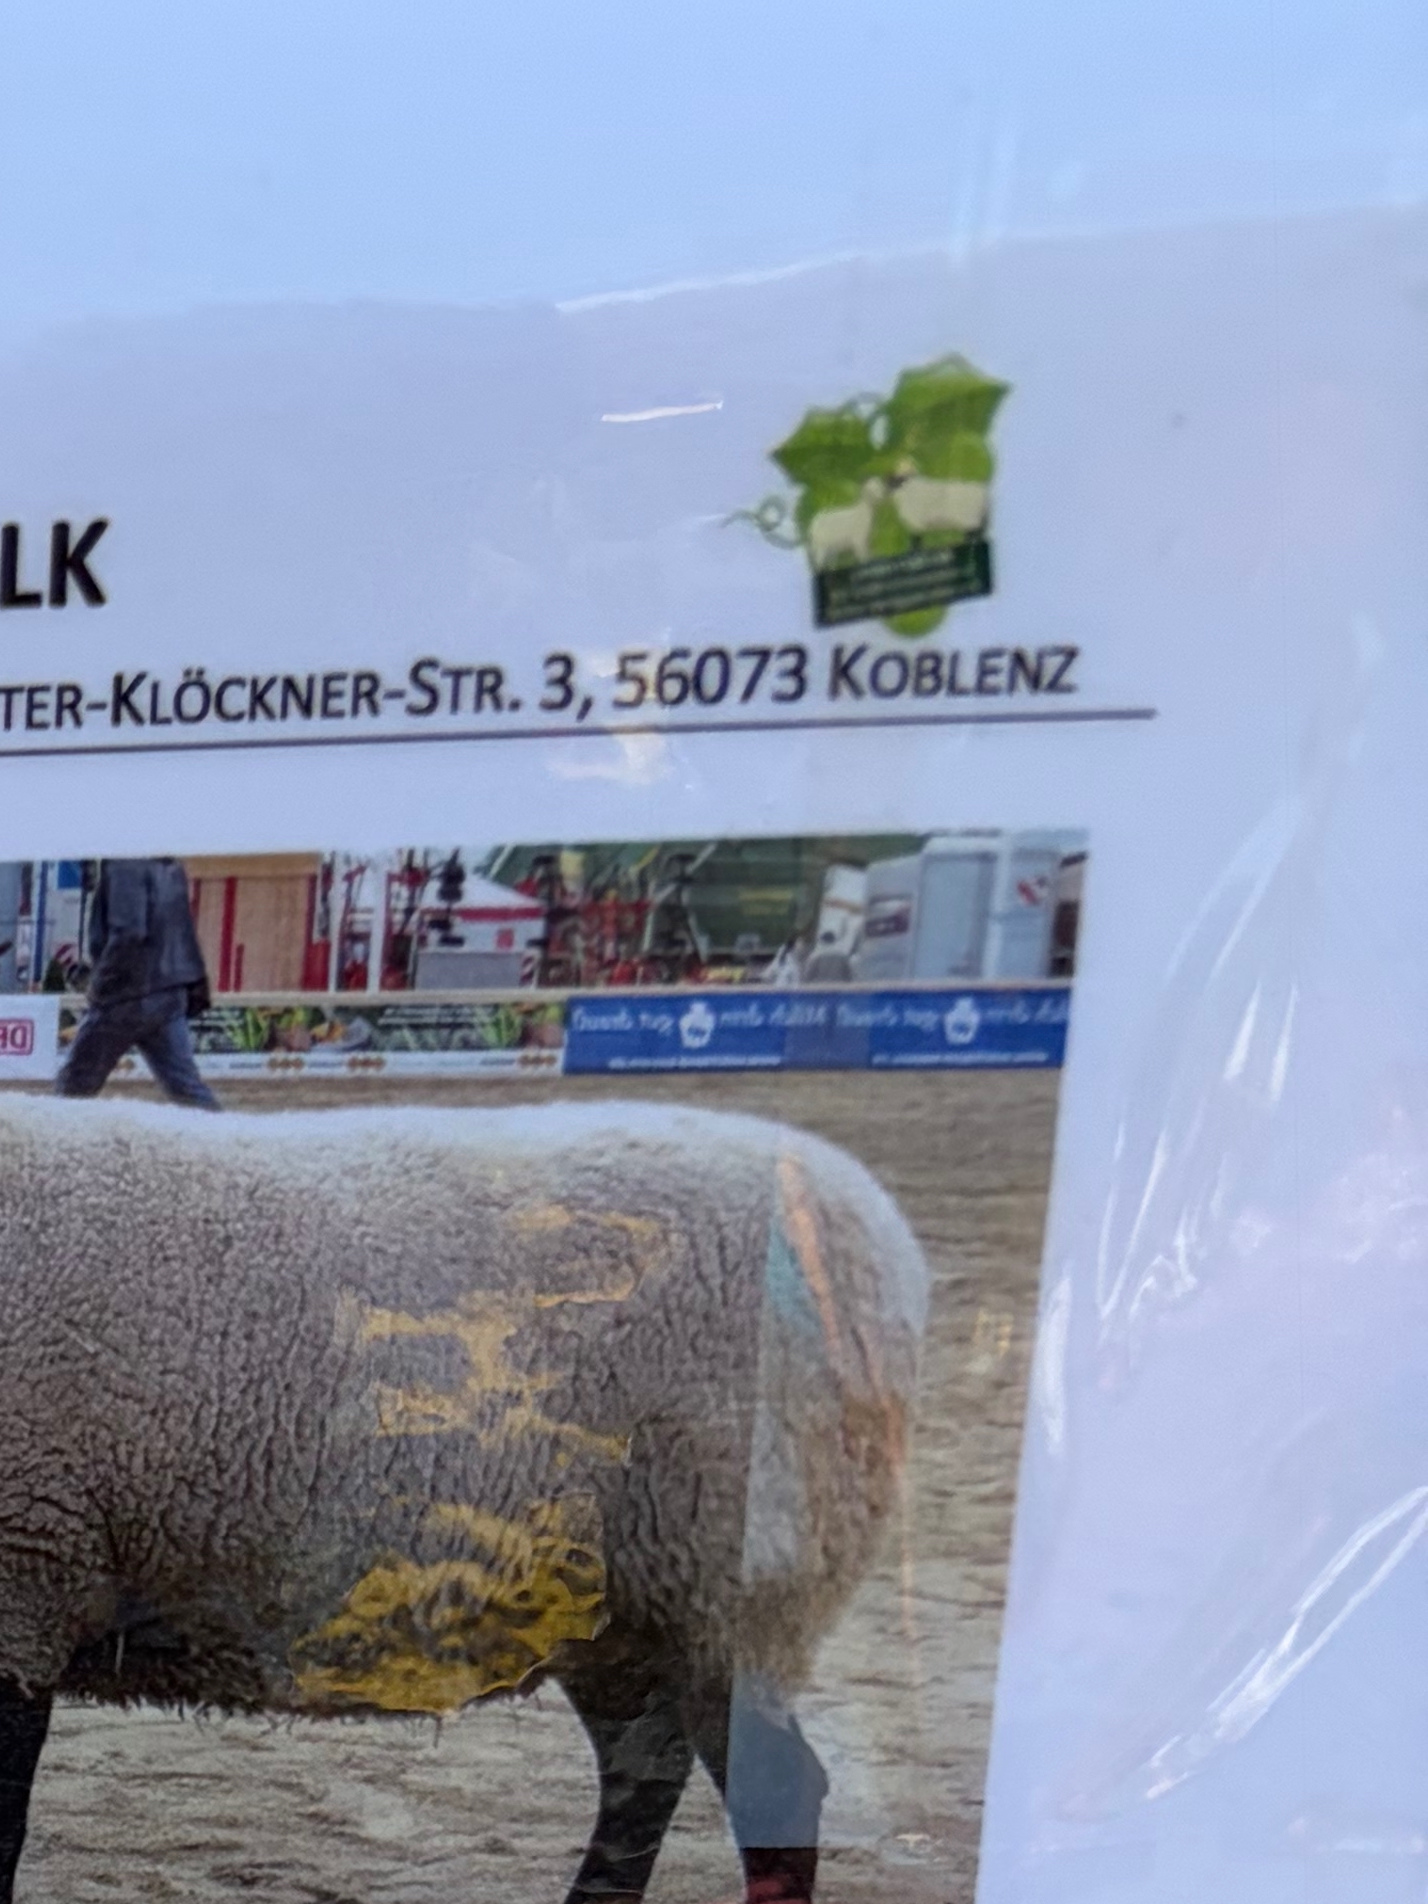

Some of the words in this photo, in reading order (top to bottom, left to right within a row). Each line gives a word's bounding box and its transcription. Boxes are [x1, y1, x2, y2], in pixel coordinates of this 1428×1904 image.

[538, 652, 594, 723] 3,
[611, 643, 809, 710] 56073
[828, 644, 1080, 701] KOBLENZ
